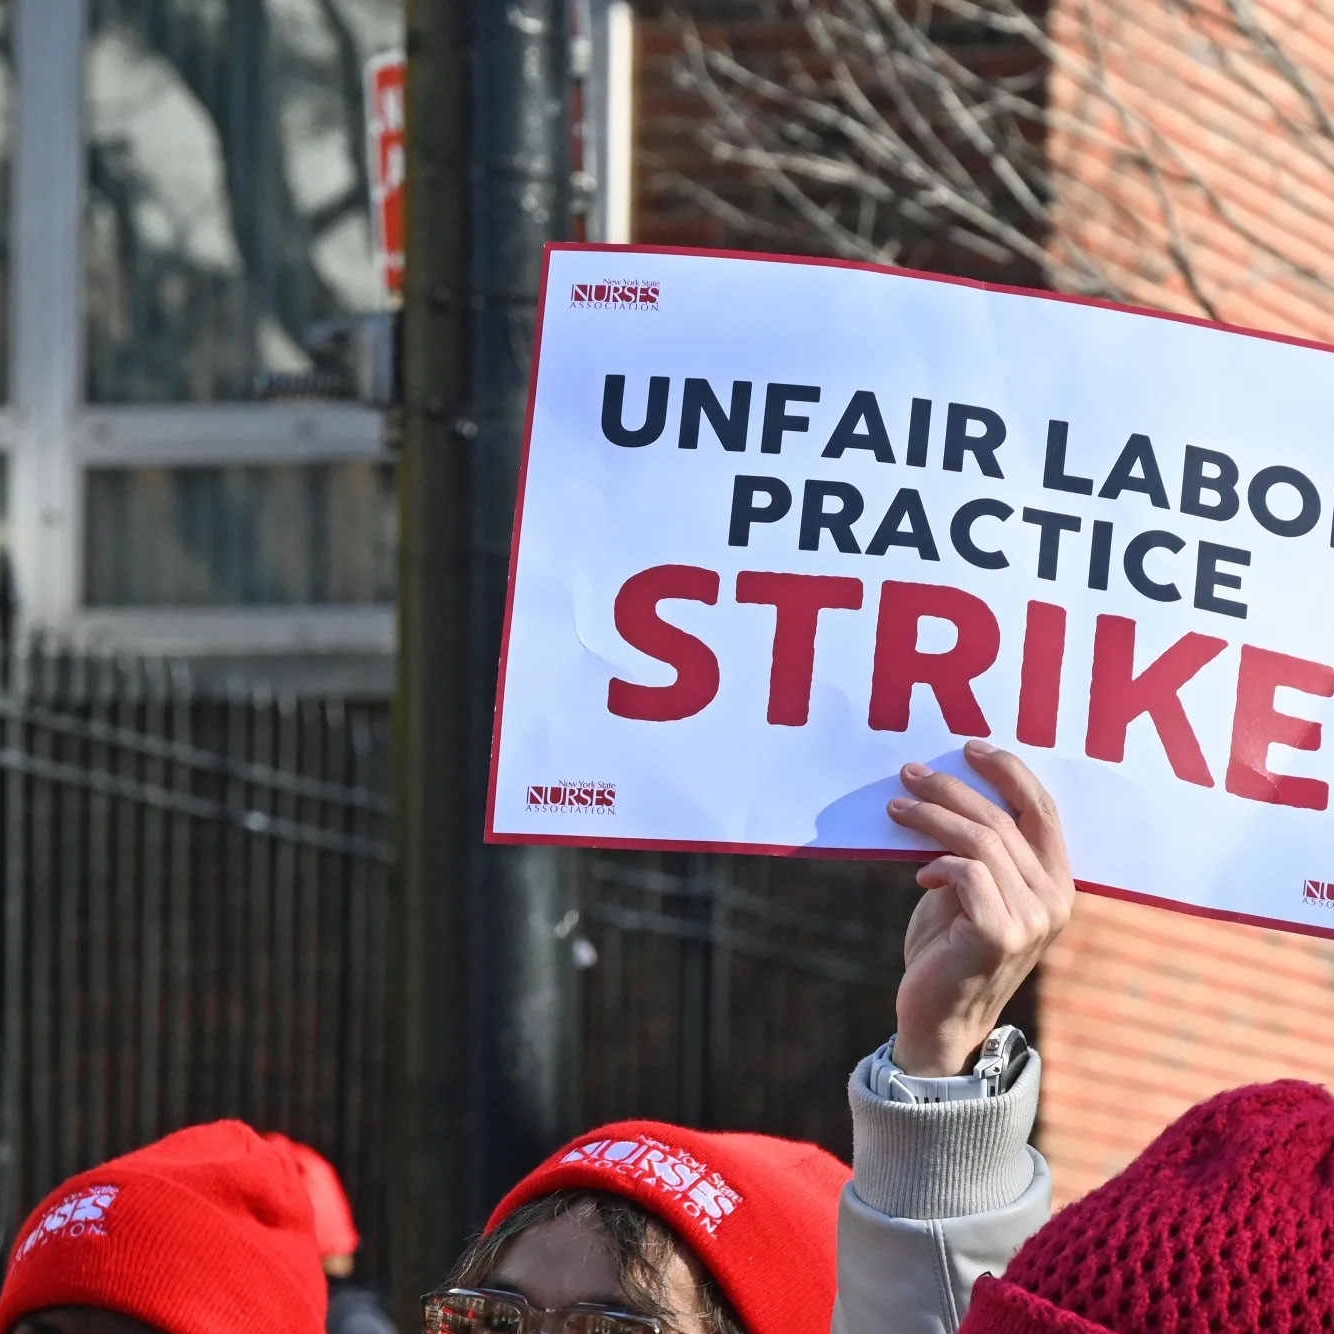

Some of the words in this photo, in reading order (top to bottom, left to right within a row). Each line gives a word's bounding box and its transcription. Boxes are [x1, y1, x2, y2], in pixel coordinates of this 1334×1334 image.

[603, 278, 622, 286] New
[623, 279, 640, 287] York
[641, 280, 661, 288] State
[571, 284, 661, 304] NURSES
[599, 373, 1006, 479] UNFAIR
[727, 475, 1252, 619] PRACTICE
[558, 779, 578, 788] New
[578, 780, 596, 789] York
[597, 780, 616, 789] State
[526, 786, 616, 807] NURSES
[677, 1147, 709, 1176] York
[707, 1172, 744, 1206] State
